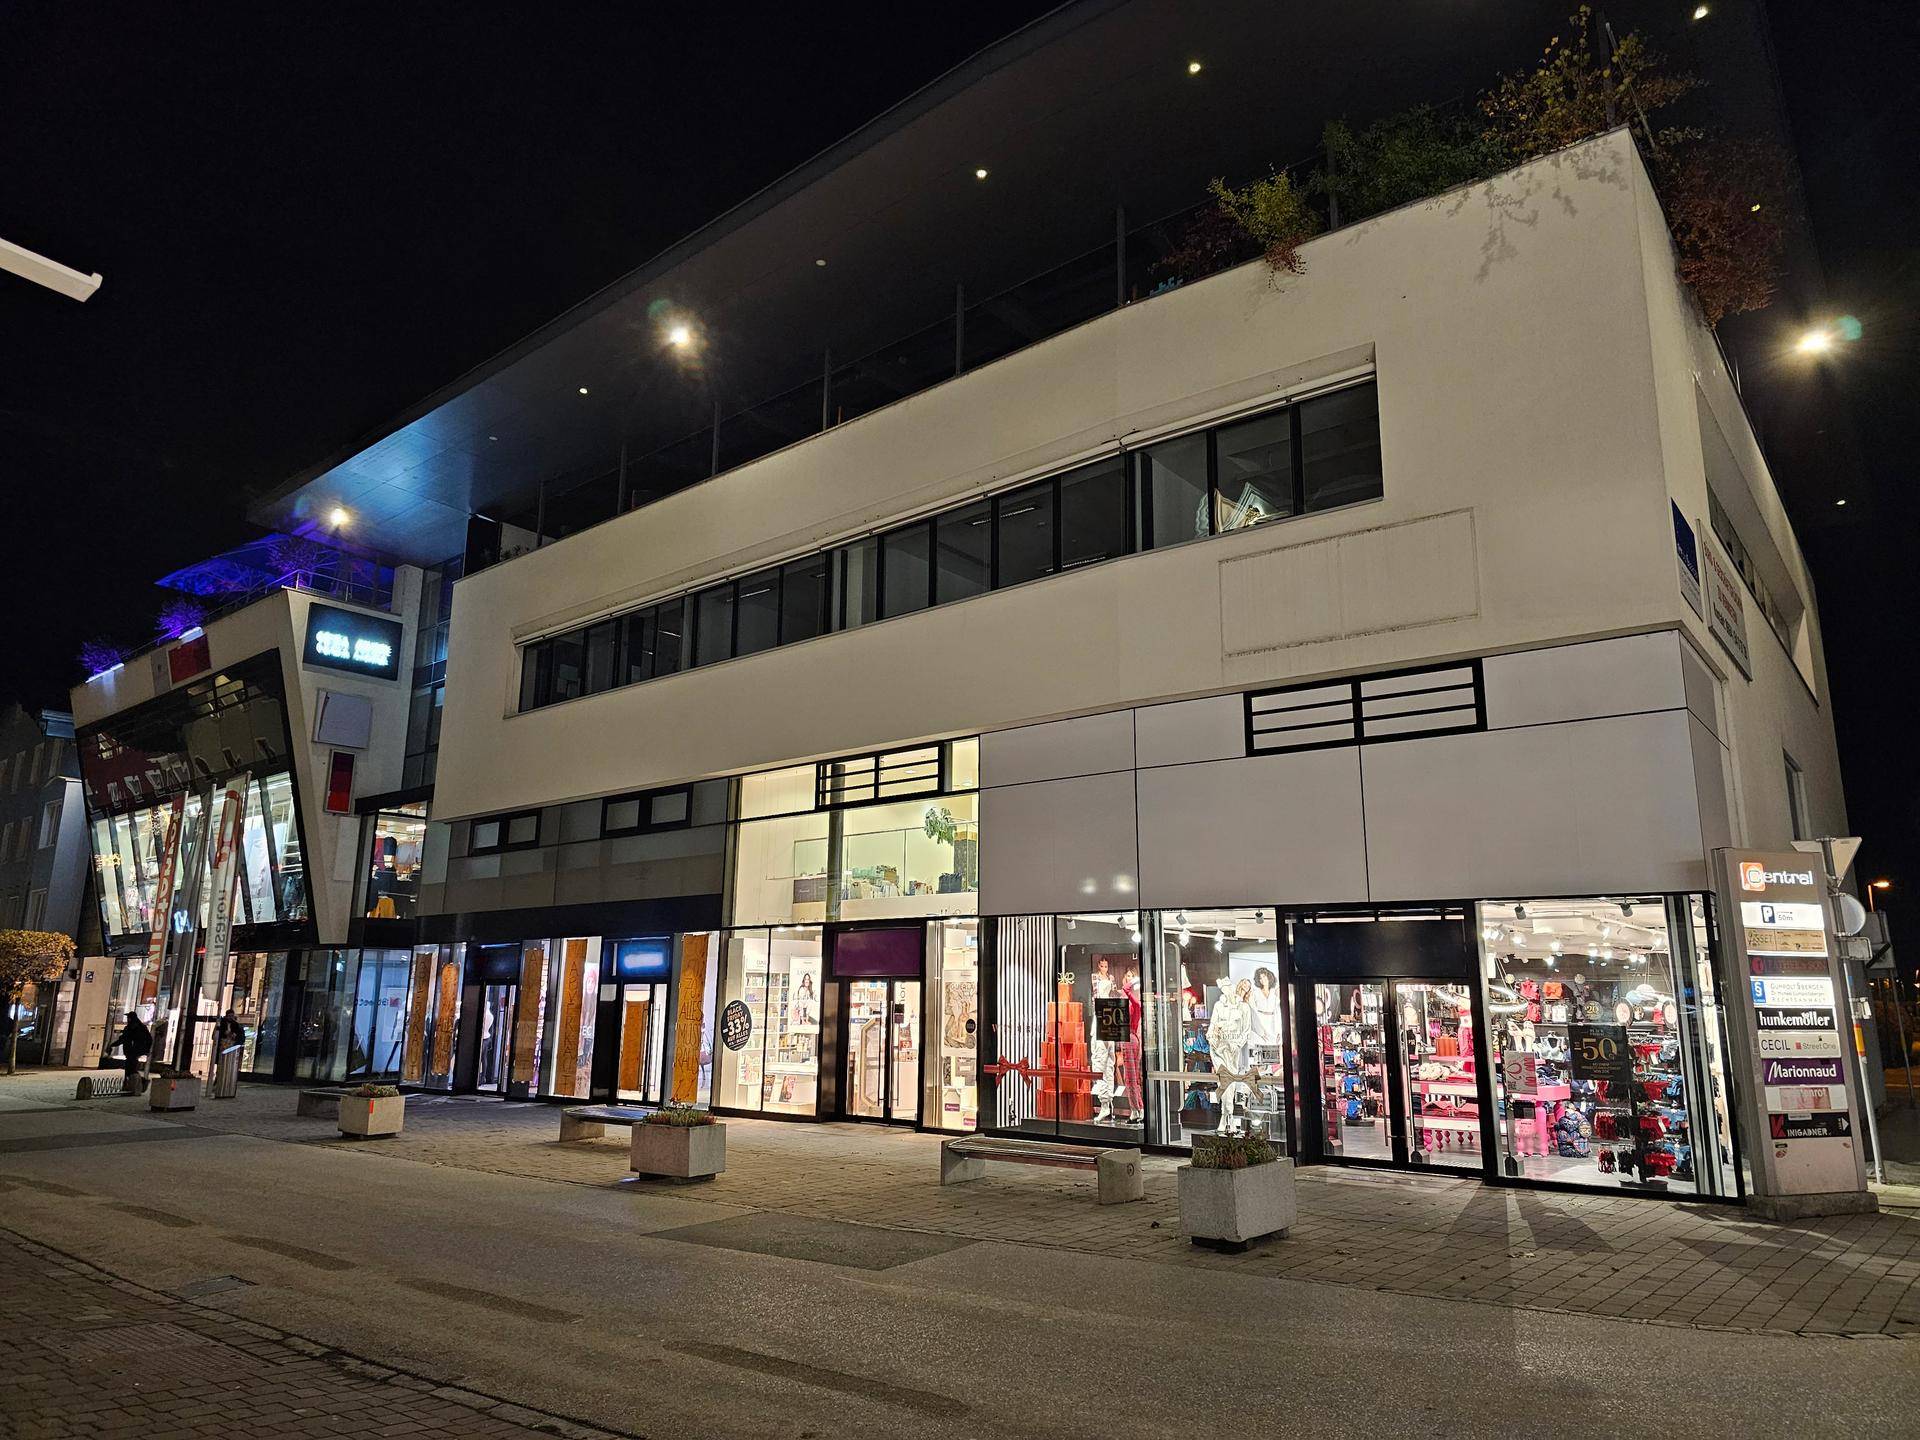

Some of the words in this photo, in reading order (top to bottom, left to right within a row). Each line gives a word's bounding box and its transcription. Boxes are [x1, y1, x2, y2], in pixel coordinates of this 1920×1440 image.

[1746, 867, 1813, 888] Central
[722, 1014, 750, 1036] -33%
[1759, 1010, 1830, 1027] hunkemöller
[1761, 1039, 1791, 1051] CECIL
[1802, 1042, 1822, 1050] Street
[1823, 1042, 1836, 1050] One
[1768, 1061, 1837, 1082] Marionnaud
